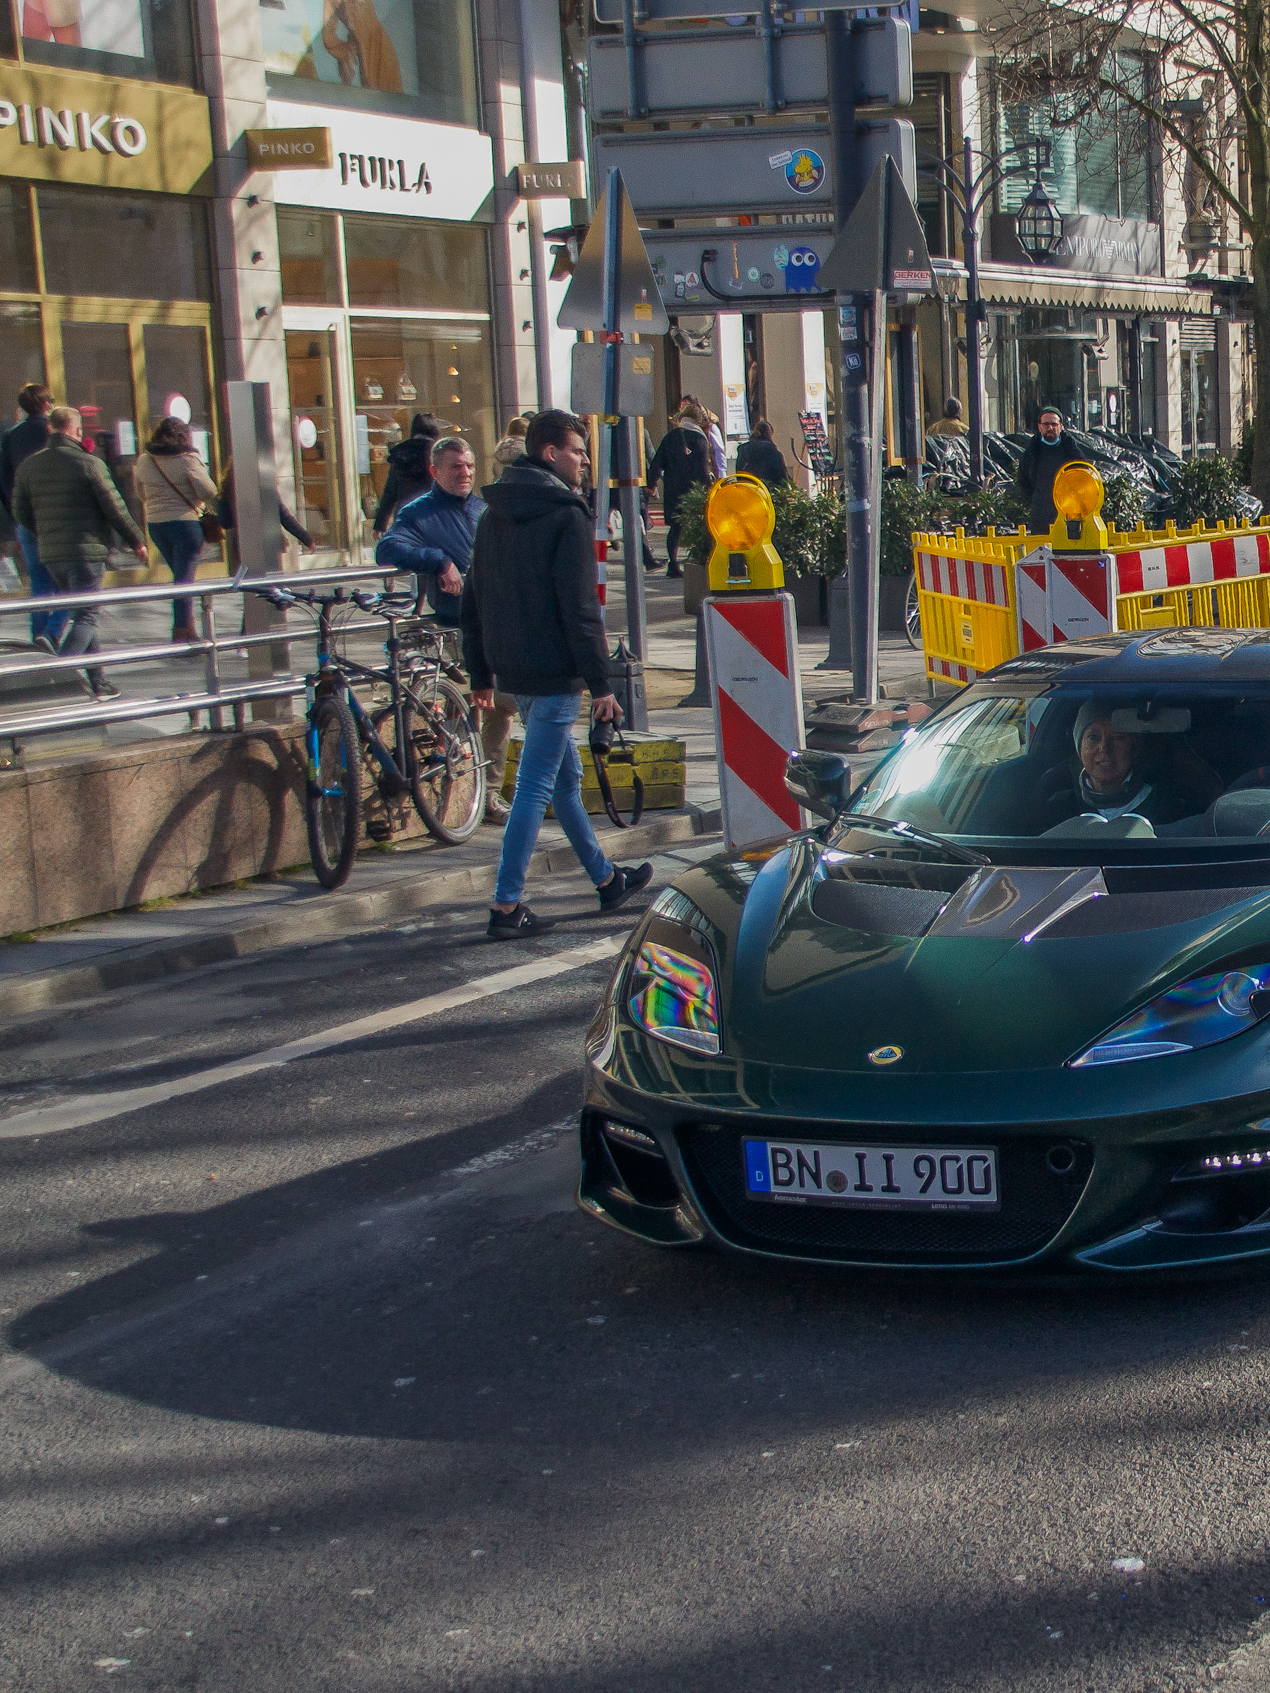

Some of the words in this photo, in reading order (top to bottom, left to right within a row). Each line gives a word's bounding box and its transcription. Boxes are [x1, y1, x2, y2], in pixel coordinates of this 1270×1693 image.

[258, 142, 316, 156] PINKO
[338, 152, 433, 195] FURLA
[521, 173, 576, 189] FURL
[894, 271, 931, 279] GERKEN
[755, 1170, 764, 1182] D
[770, 1146, 823, 1189] BN
[853, 1152, 901, 1193] II
[913, 1153, 993, 1195] 900
